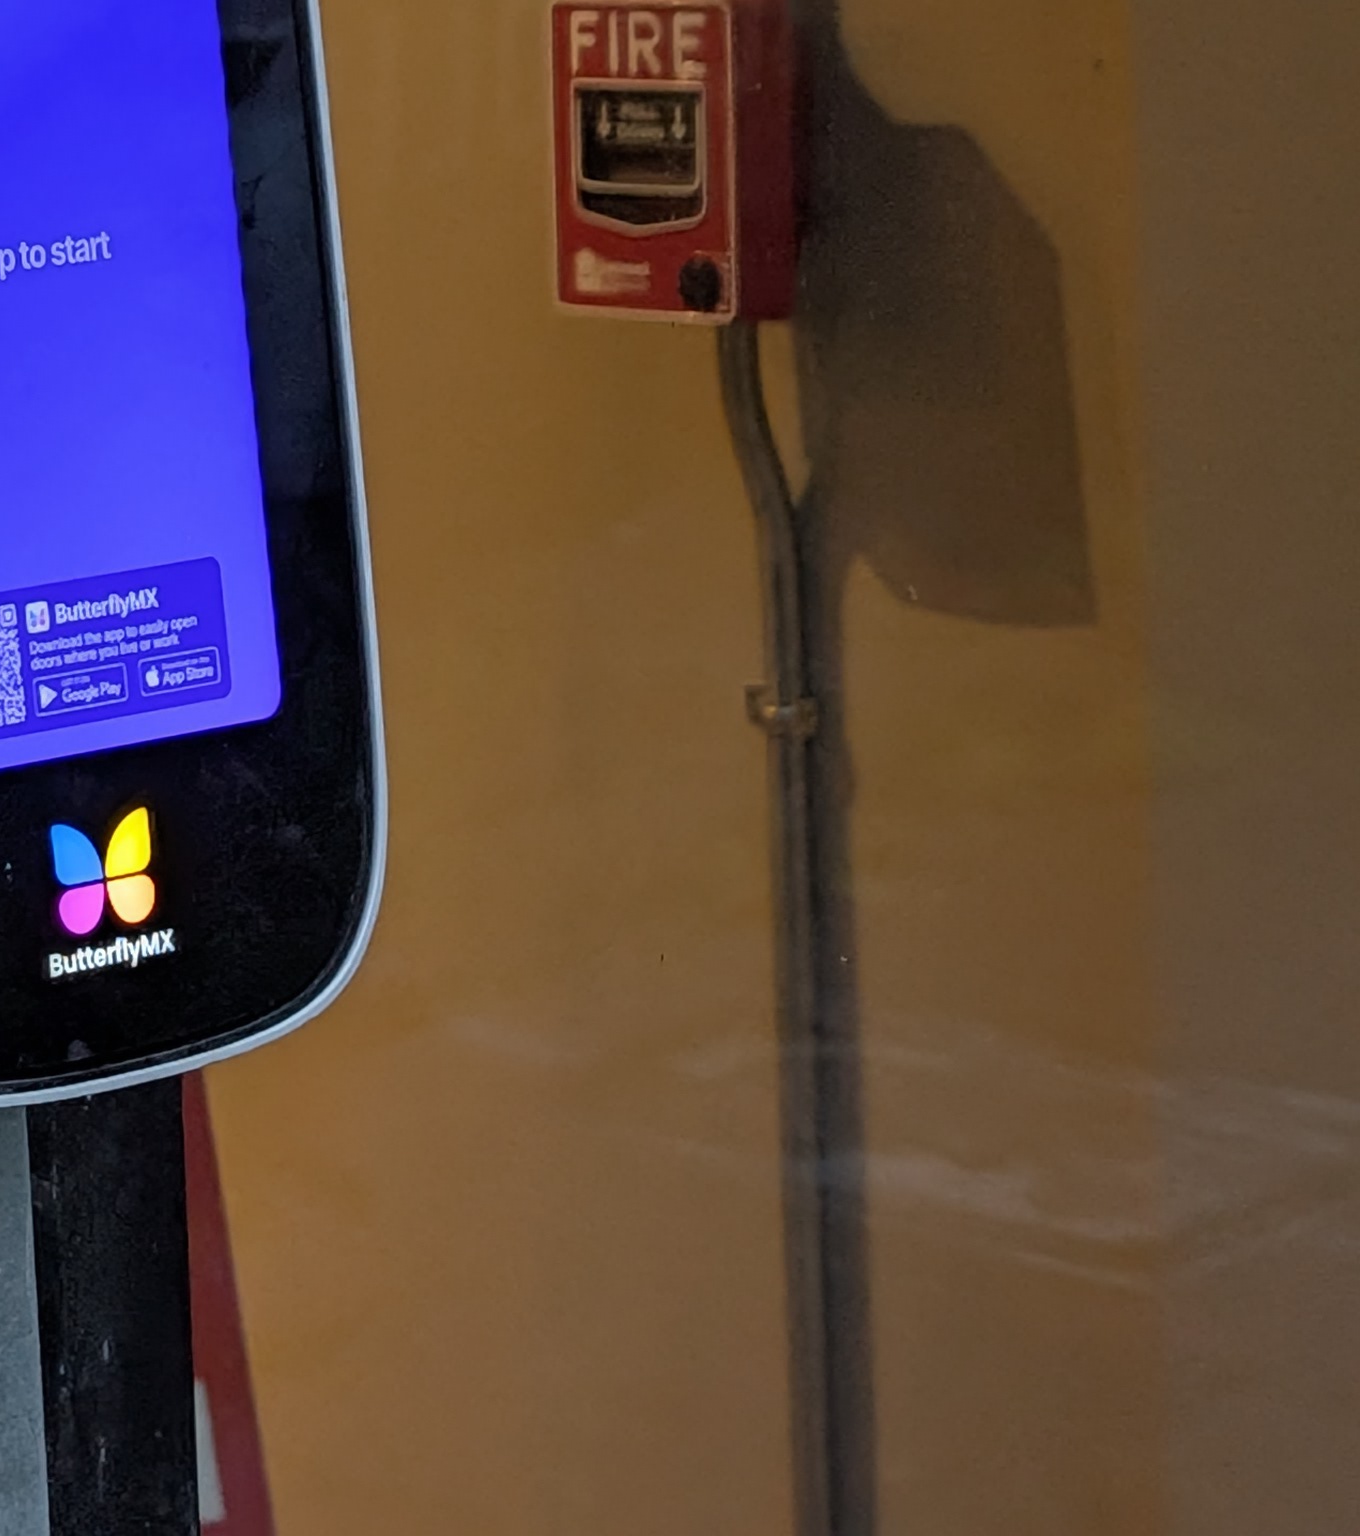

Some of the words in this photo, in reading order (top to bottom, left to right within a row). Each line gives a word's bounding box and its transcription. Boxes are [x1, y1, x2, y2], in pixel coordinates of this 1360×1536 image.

[569, 10, 707, 79] FIRE
[19, 240, 47, 270] to
[51, 231, 111, 265] start
[55, 587, 159, 624] ButterflyMX
[62, 685, 99, 703] Google
[100, 681, 121, 697] Play
[162, 671, 185, 686] App
[186, 666, 214, 681] Store
[49, 928, 176, 979] ButterflyMX
